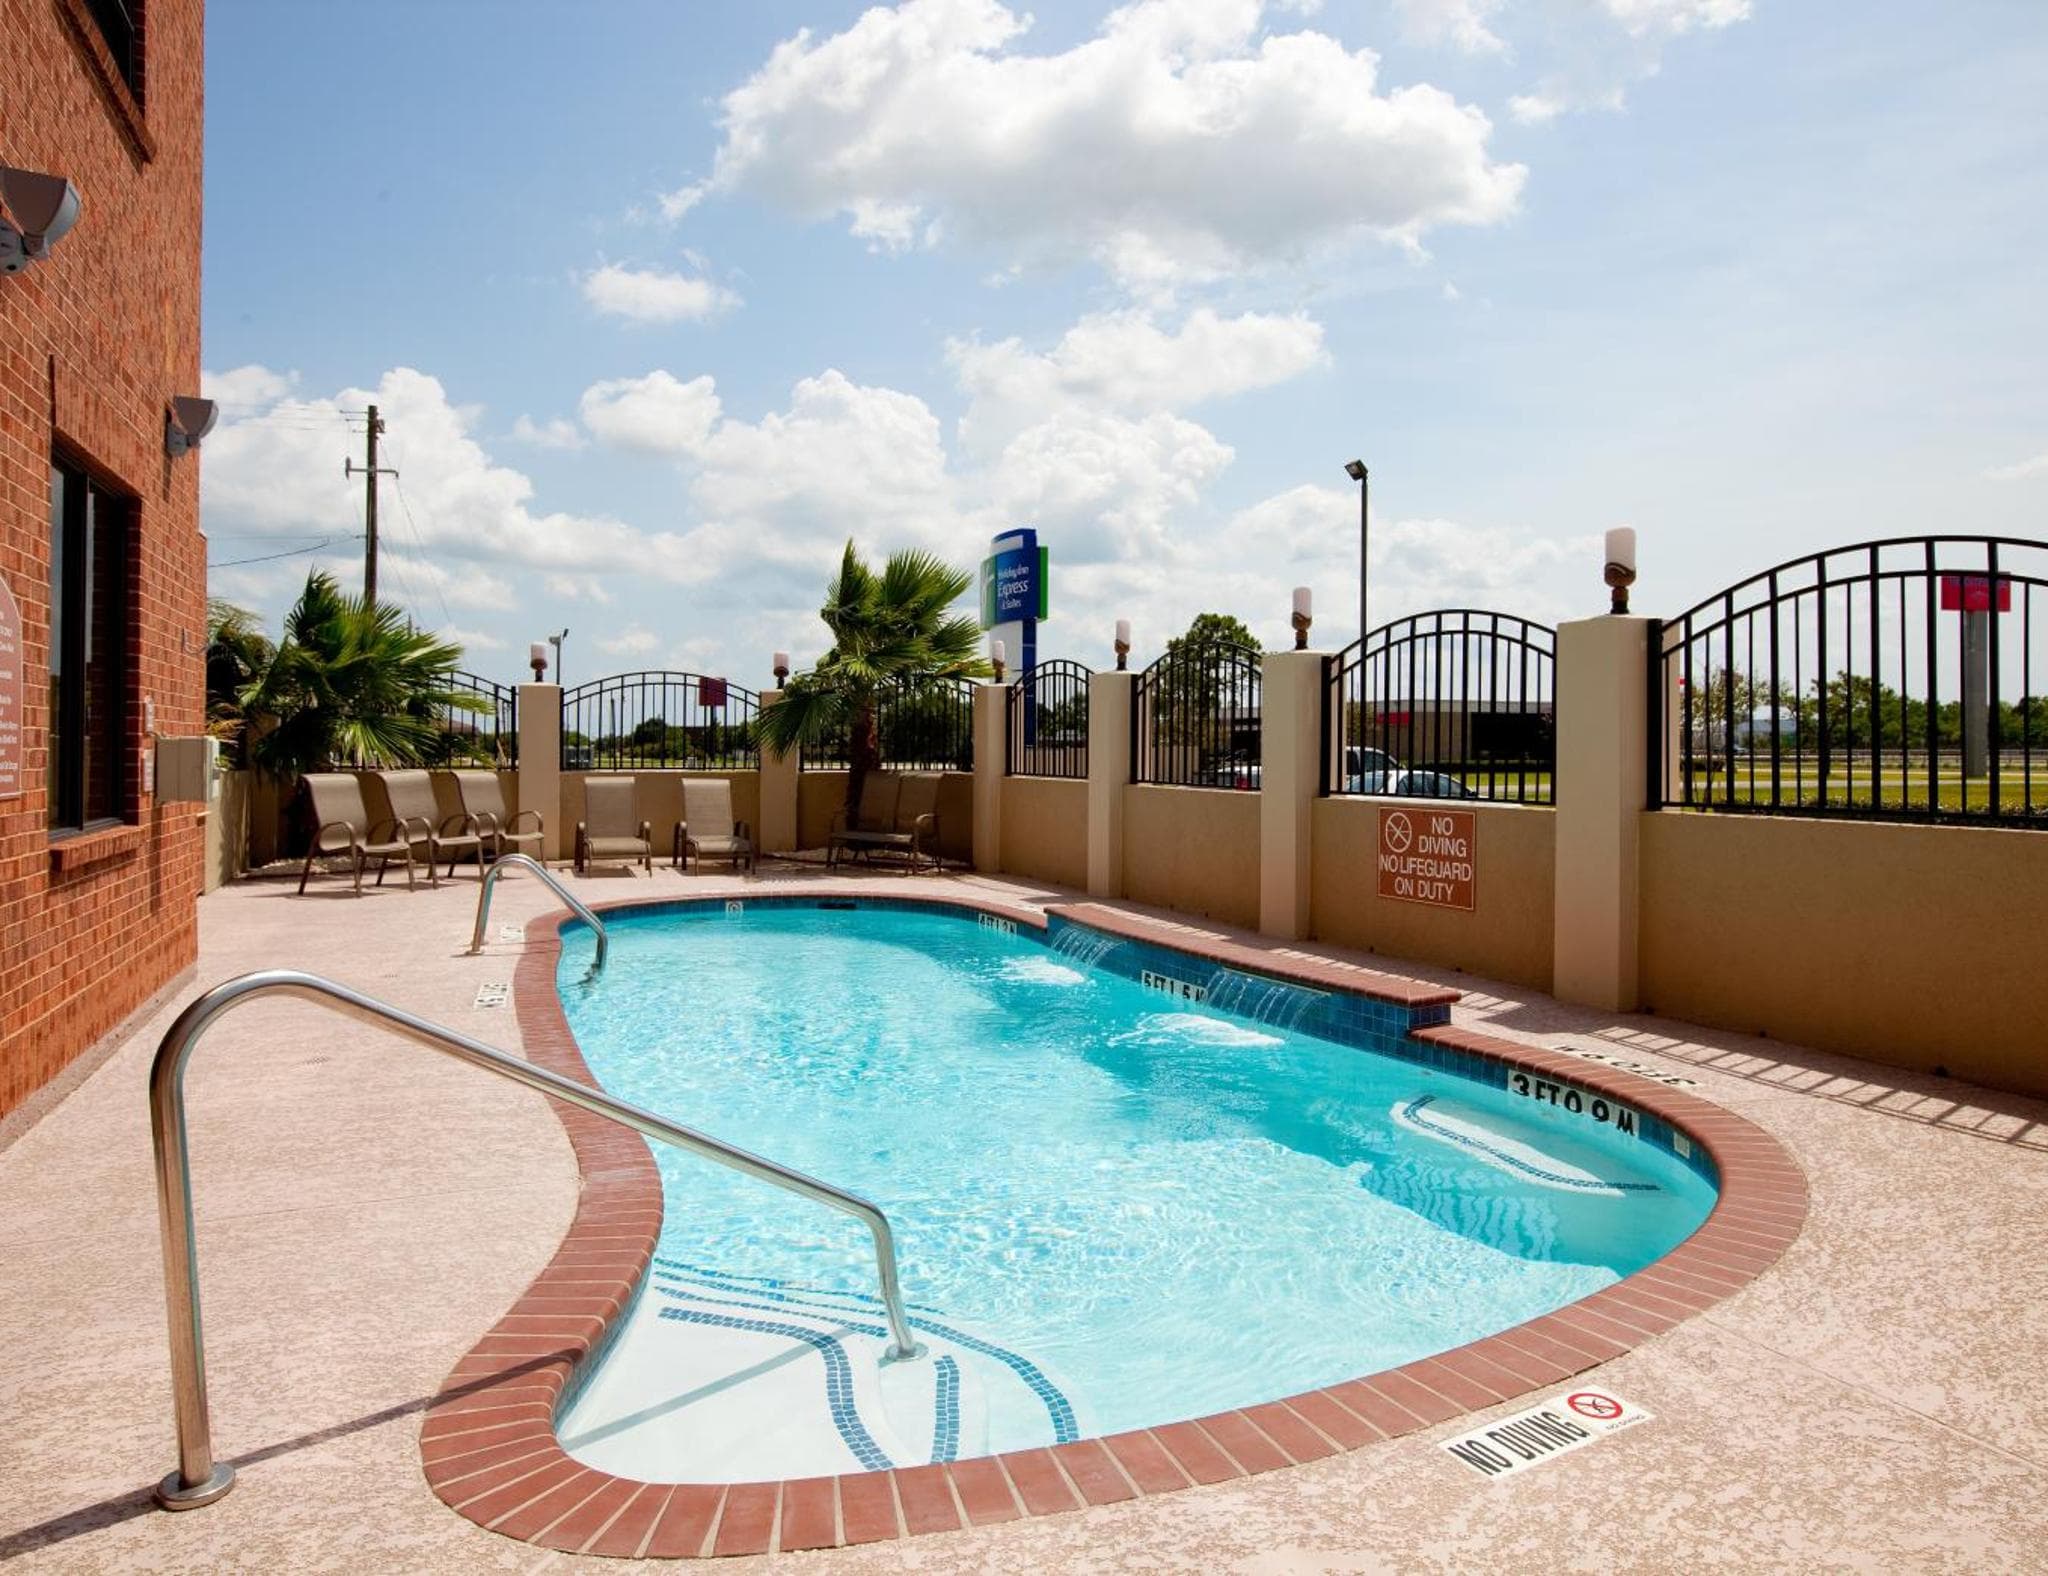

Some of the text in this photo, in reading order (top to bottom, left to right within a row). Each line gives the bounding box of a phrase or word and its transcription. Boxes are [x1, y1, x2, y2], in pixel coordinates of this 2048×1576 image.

[997, 580, 1029, 599] Express
[1431, 817, 1453, 836] NO
[1418, 835, 1467, 857] DIVING
[1380, 854, 1472, 881] NO LIFEGUARD
[1394, 877, 1454, 901] ON DUTY
[1448, 1411, 1591, 1475] NO DIVING
